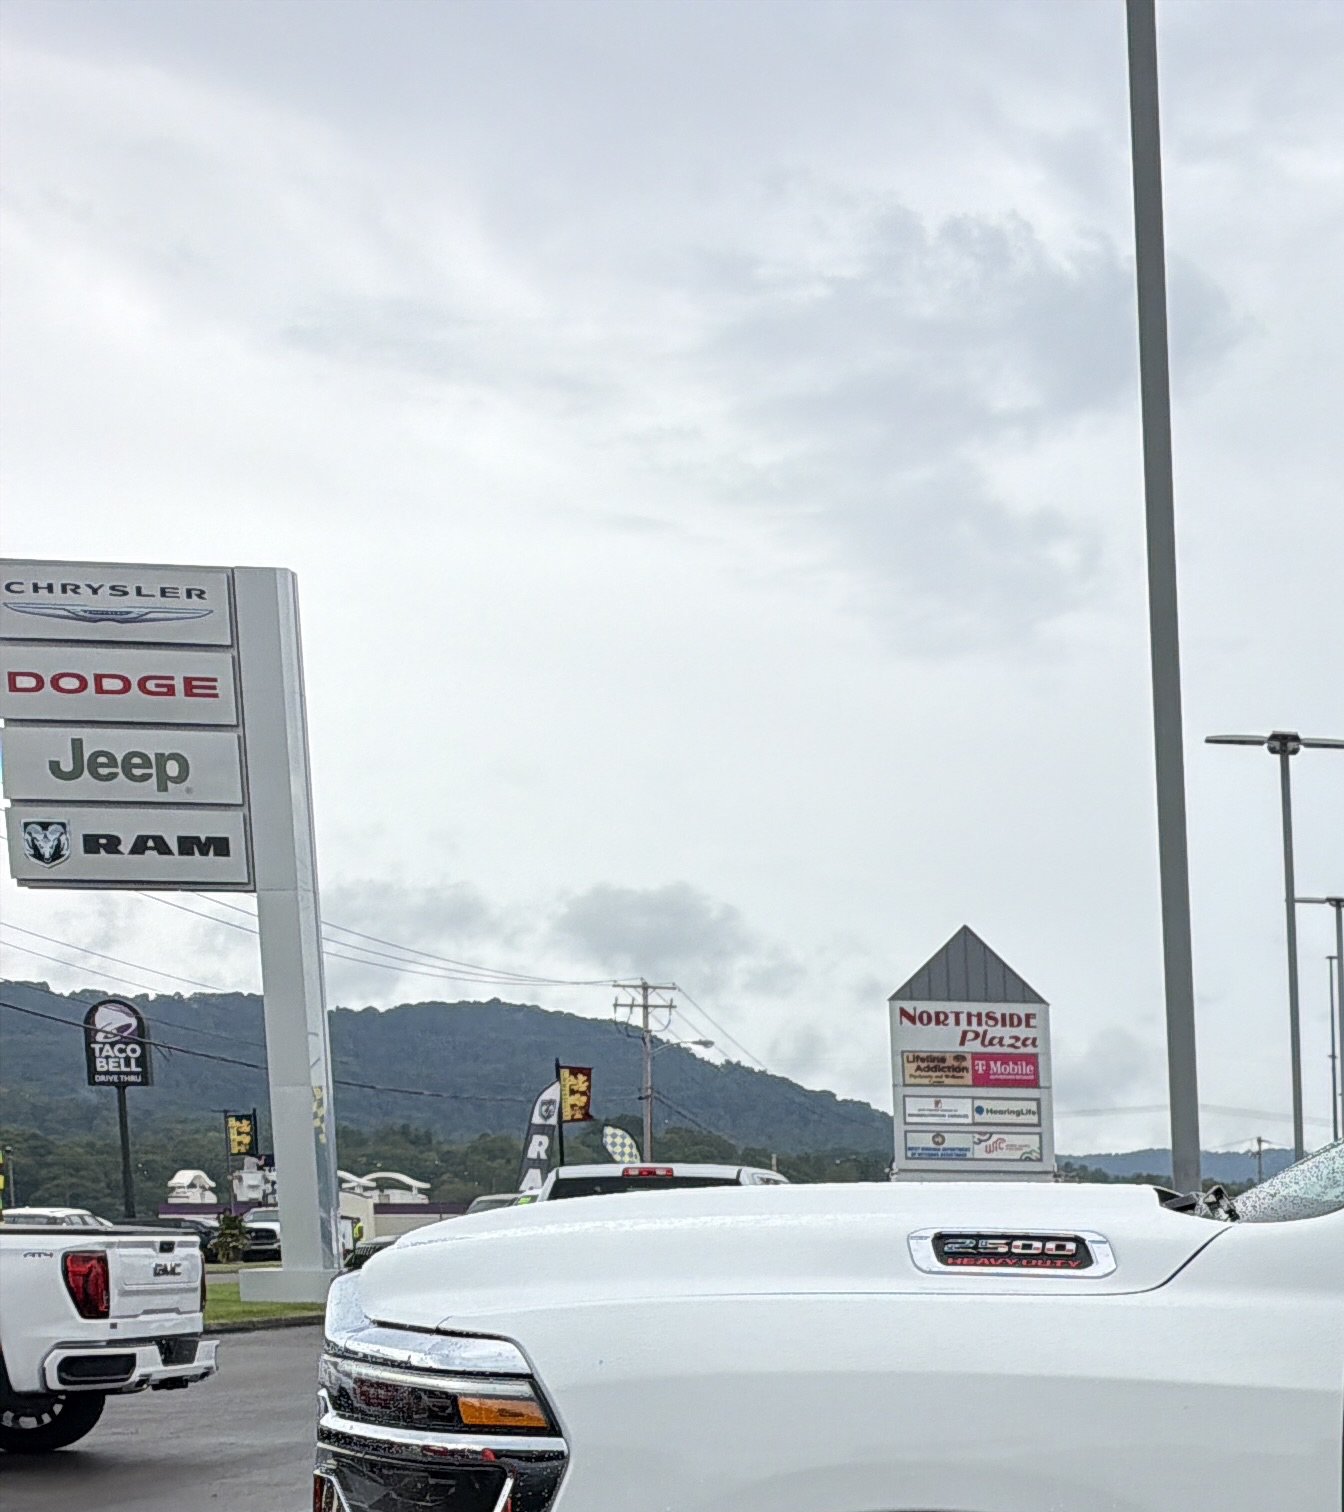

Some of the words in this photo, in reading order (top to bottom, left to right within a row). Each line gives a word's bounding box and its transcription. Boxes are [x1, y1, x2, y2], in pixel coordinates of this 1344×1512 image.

[5, 581, 207, 601] CHRYSLER
[7, 671, 219, 698] DODGE
[48, 738, 190, 792] Jeep
[82, 833, 231, 857] RAM
[899, 1006, 1037, 1028] NORTHSIDE
[959, 1029, 1039, 1049] Plaza
[90, 1043, 141, 1058] TACO
[96, 1058, 142, 1072] BELL
[914, 1065, 969, 1074] Addiction
[989, 1061, 1035, 1075] Mobile
[944, 1239, 1077, 1255] 2500
[947, 1257, 1017, 1266] HEAVY
[1022, 1258, 1082, 1267] DUTY
